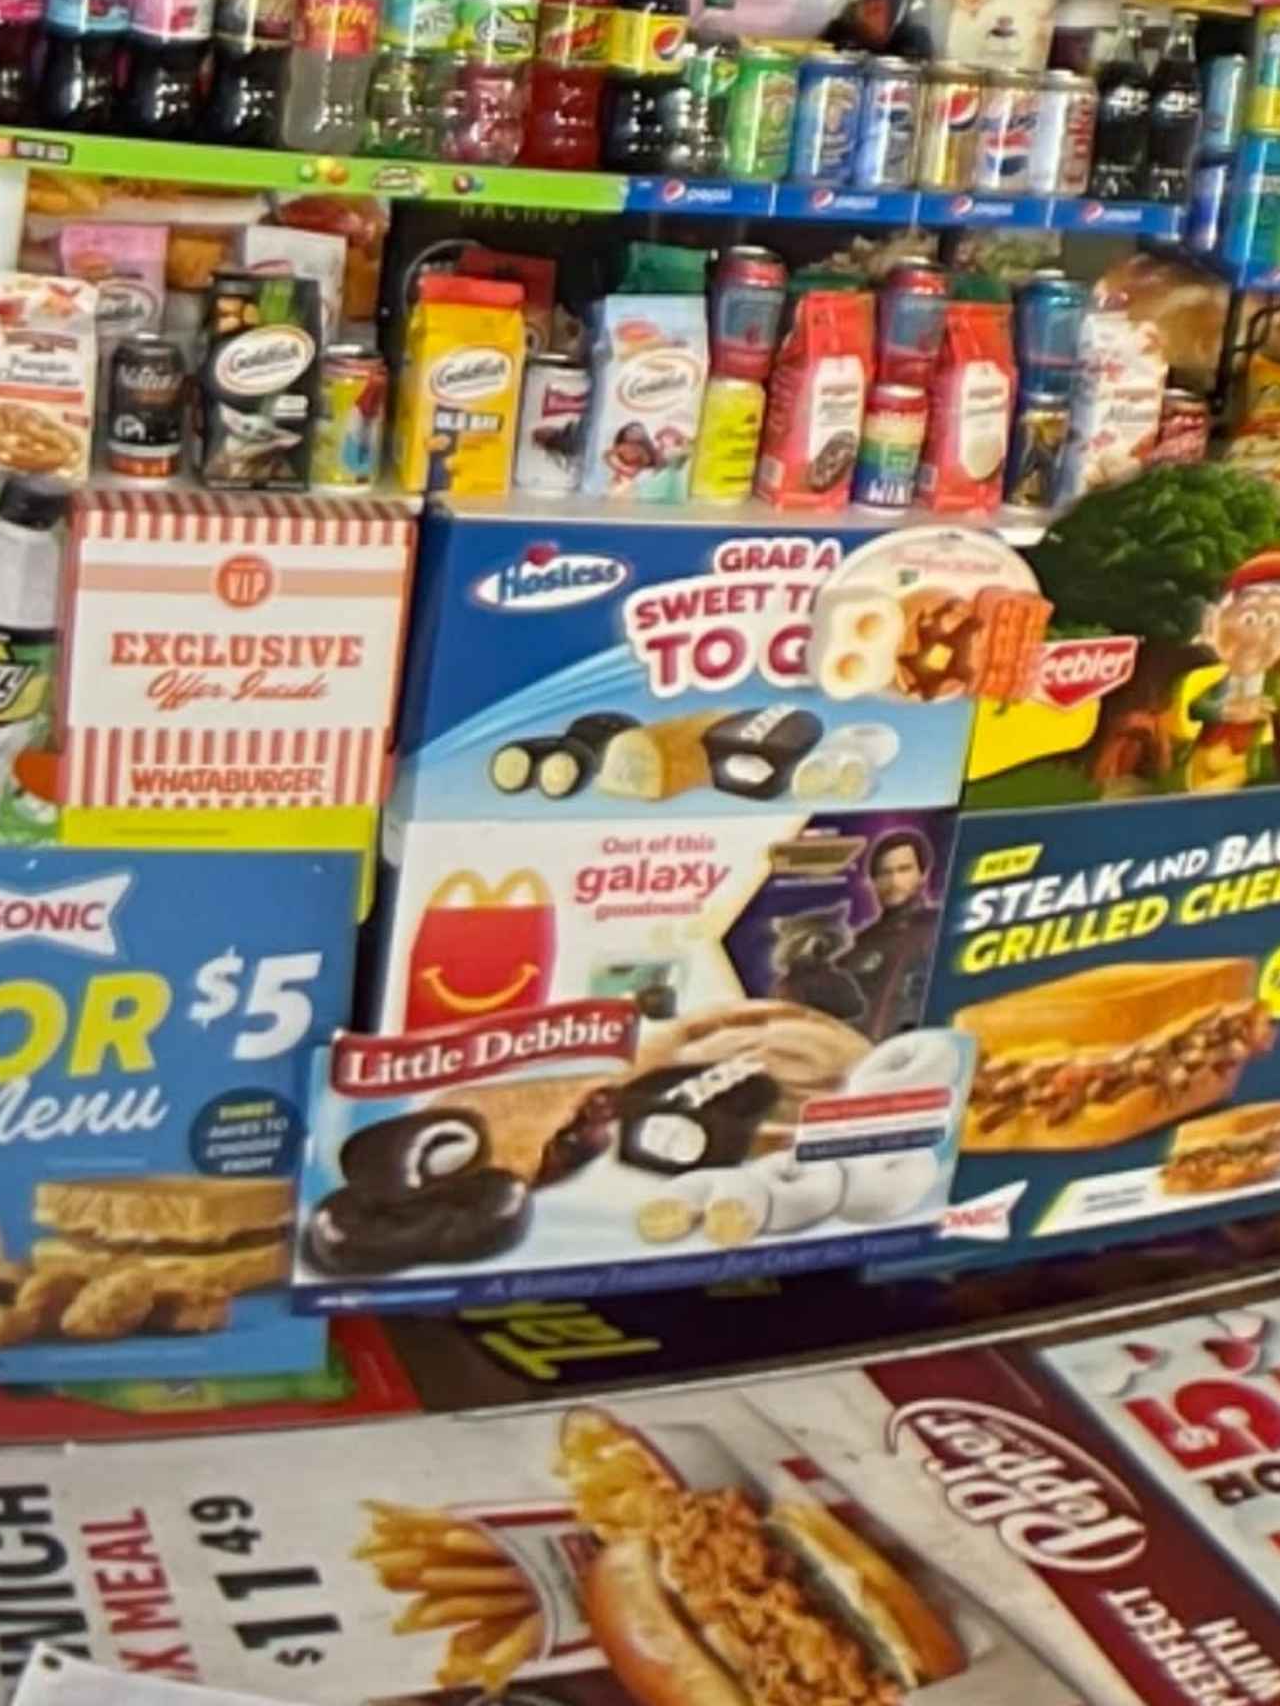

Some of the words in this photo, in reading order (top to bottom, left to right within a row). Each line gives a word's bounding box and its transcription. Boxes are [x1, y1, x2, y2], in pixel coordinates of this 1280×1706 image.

[498, 554, 622, 599] Hostess
[718, 543, 805, 575] GRAB
[810, 546, 837, 574] A
[226, 568, 267, 600] VIP
[633, 585, 780, 631] SWEET
[111, 631, 365, 668] EXCLUSIVE
[647, 635, 749, 686] TO
[145, 670, 224, 711] Offer
[231, 675, 329, 702] Inside
[131, 765, 324, 796] WHATABURGER
[601, 836, 642, 856] Out
[646, 835, 670, 856] of
[673, 833, 716, 855] this
[574, 858, 730, 905] galaxy
[965, 861, 1132, 930] STEAK
[1135, 848, 1208, 890] AND
[962, 897, 1170, 974] GRILLED
[188, 945, 322, 1063] $5
[346, 1034, 465, 1084] Little
[473, 1014, 627, 1068] Debbie
[925, 1406, 1135, 1571] Pepper
[81, 1508, 182, 1634] MEAL
